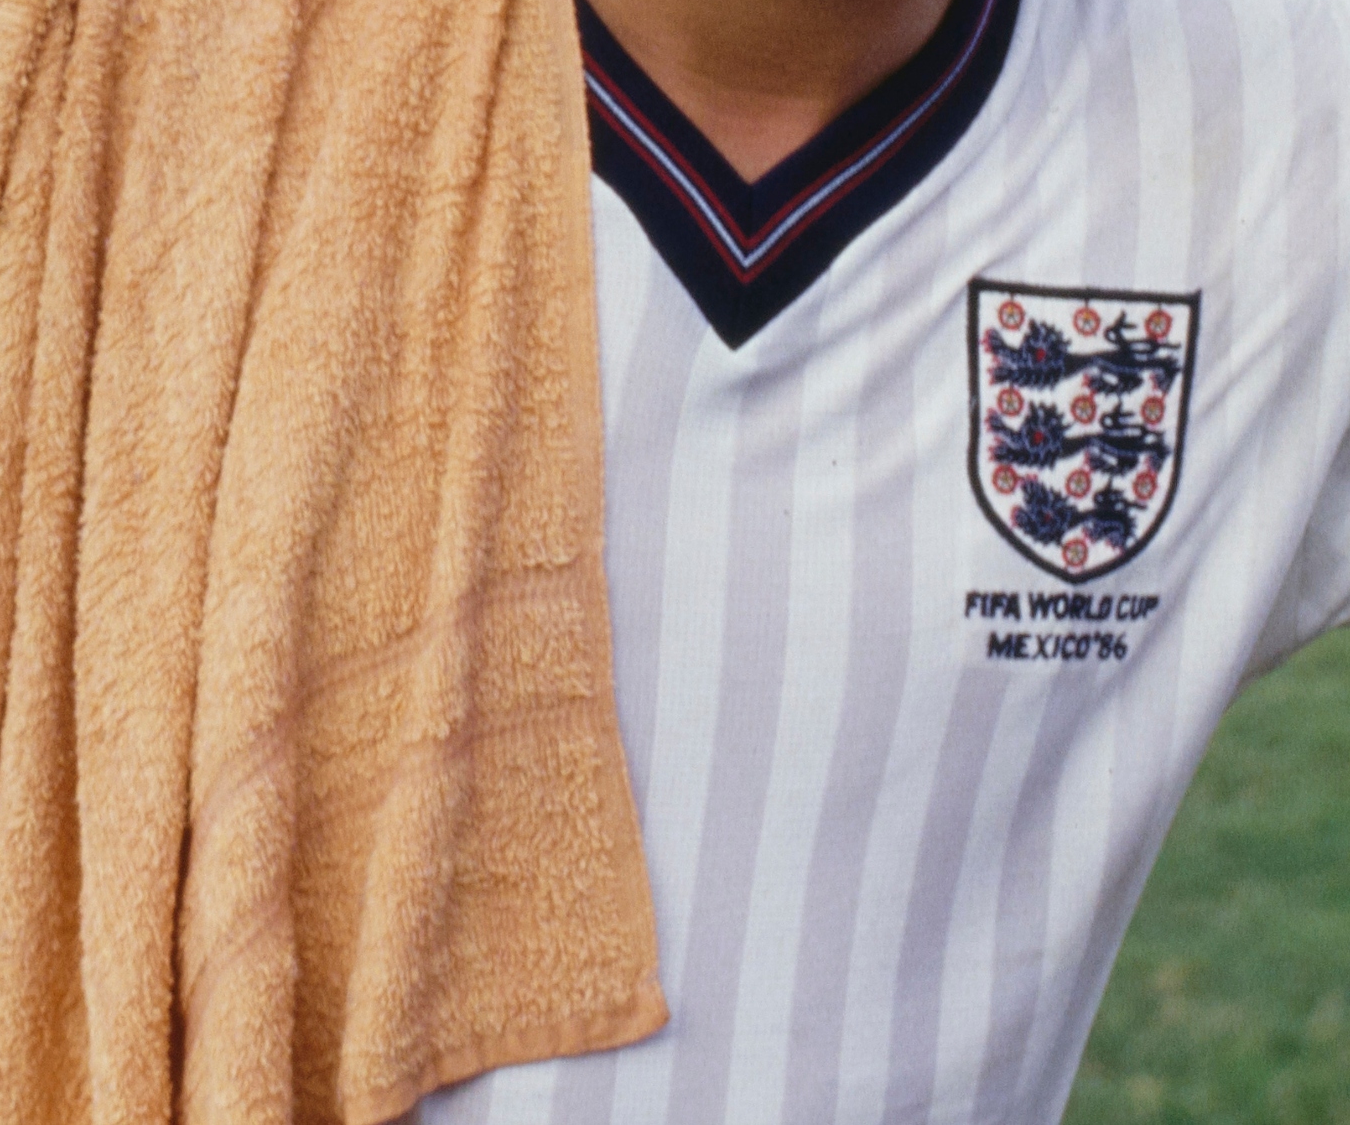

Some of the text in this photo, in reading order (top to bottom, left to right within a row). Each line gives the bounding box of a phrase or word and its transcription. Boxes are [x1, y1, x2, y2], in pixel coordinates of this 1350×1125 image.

[964, 591, 1159, 621] FIFA WORLD CUP
